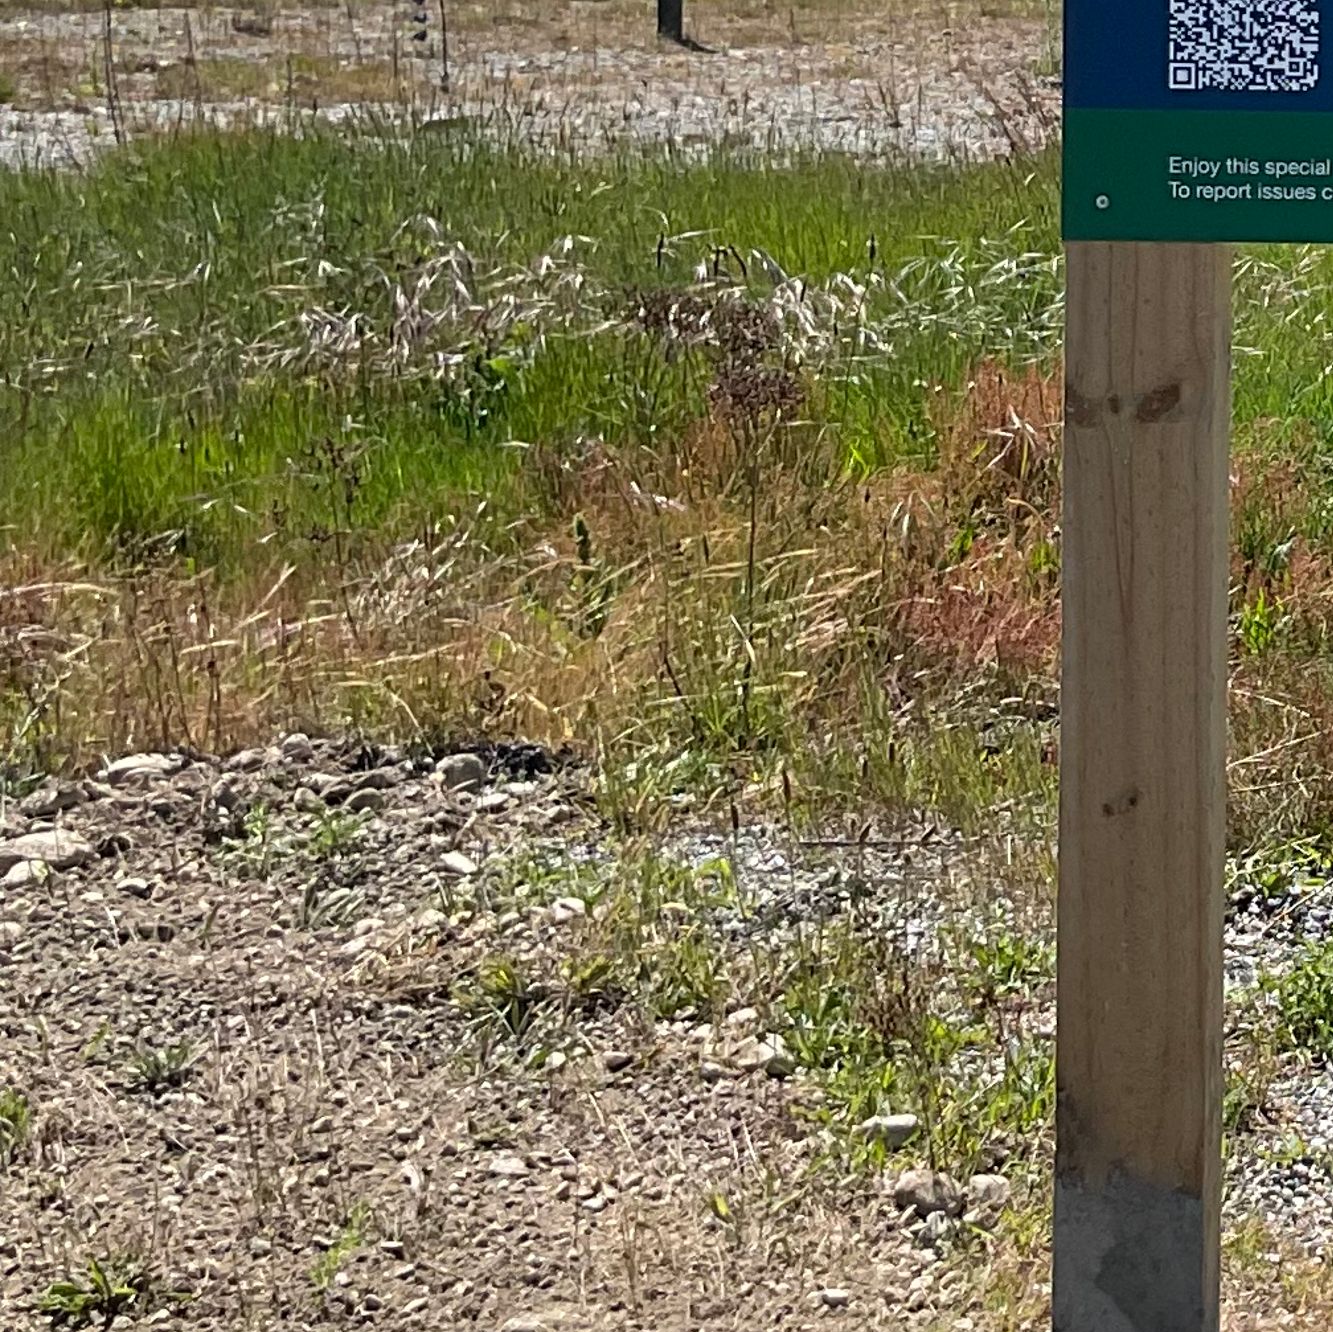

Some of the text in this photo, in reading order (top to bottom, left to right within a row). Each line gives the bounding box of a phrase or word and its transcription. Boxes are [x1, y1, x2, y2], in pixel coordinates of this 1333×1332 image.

[1169, 156, 1222, 178] Enjoy
[1225, 157, 1260, 175] this
[1264, 158, 1331, 179] special
[1168, 180, 1191, 199] To
[1196, 182, 1252, 203] report
[1257, 182, 1317, 200] issues
